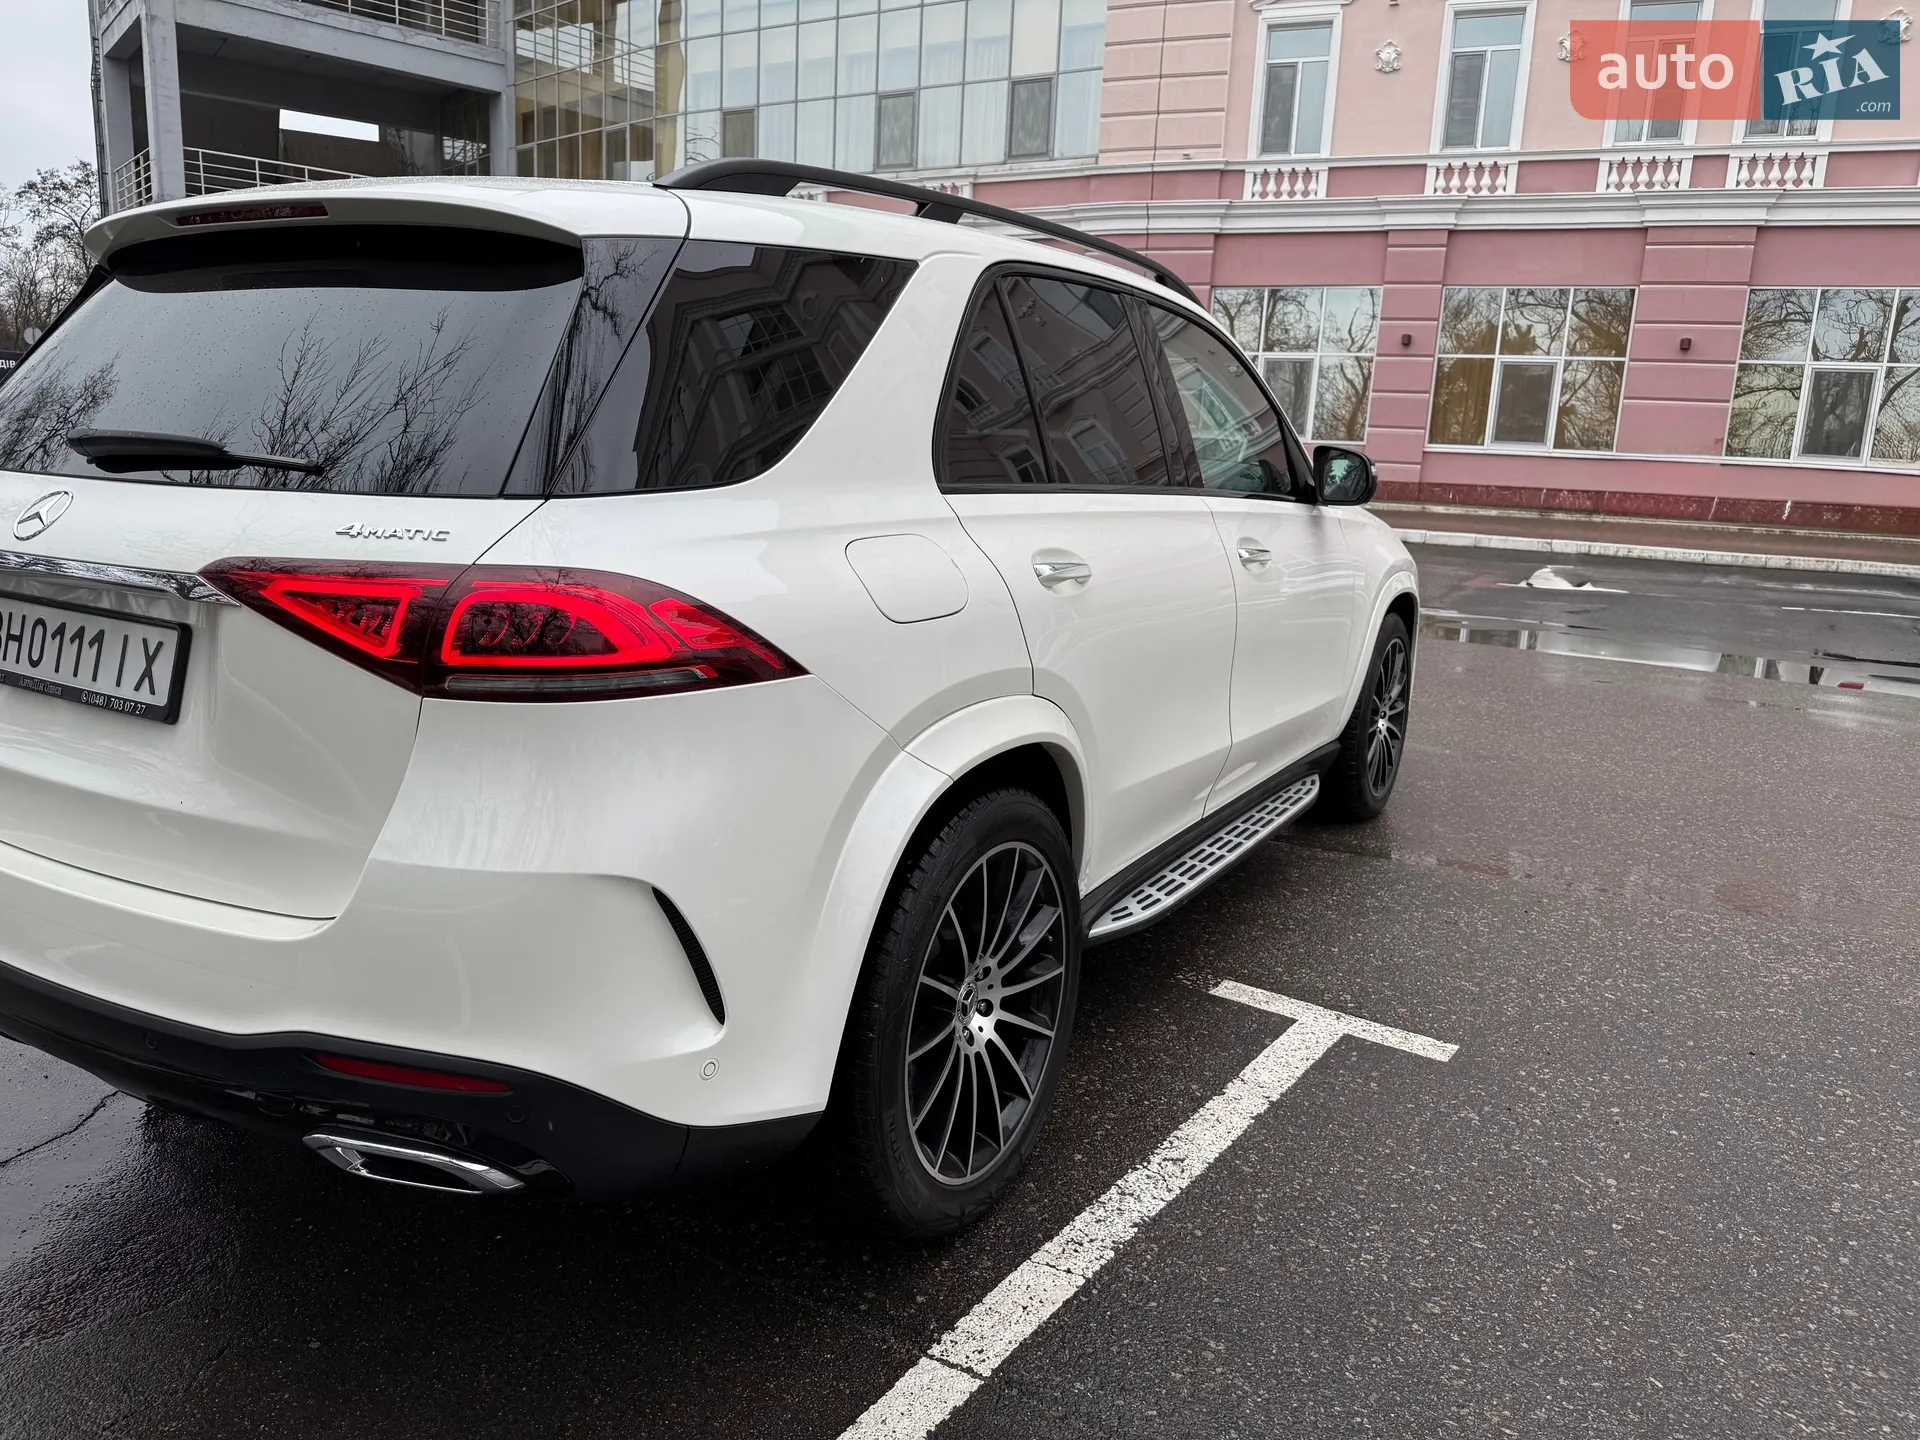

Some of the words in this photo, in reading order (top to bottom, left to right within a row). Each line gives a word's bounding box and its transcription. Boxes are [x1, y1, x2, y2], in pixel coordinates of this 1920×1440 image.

[335, 521, 451, 542] 4MATIC
[109, 697, 123, 711] 703
[124, 701, 135, 713] 07
[135, 703, 146, 715] 27
